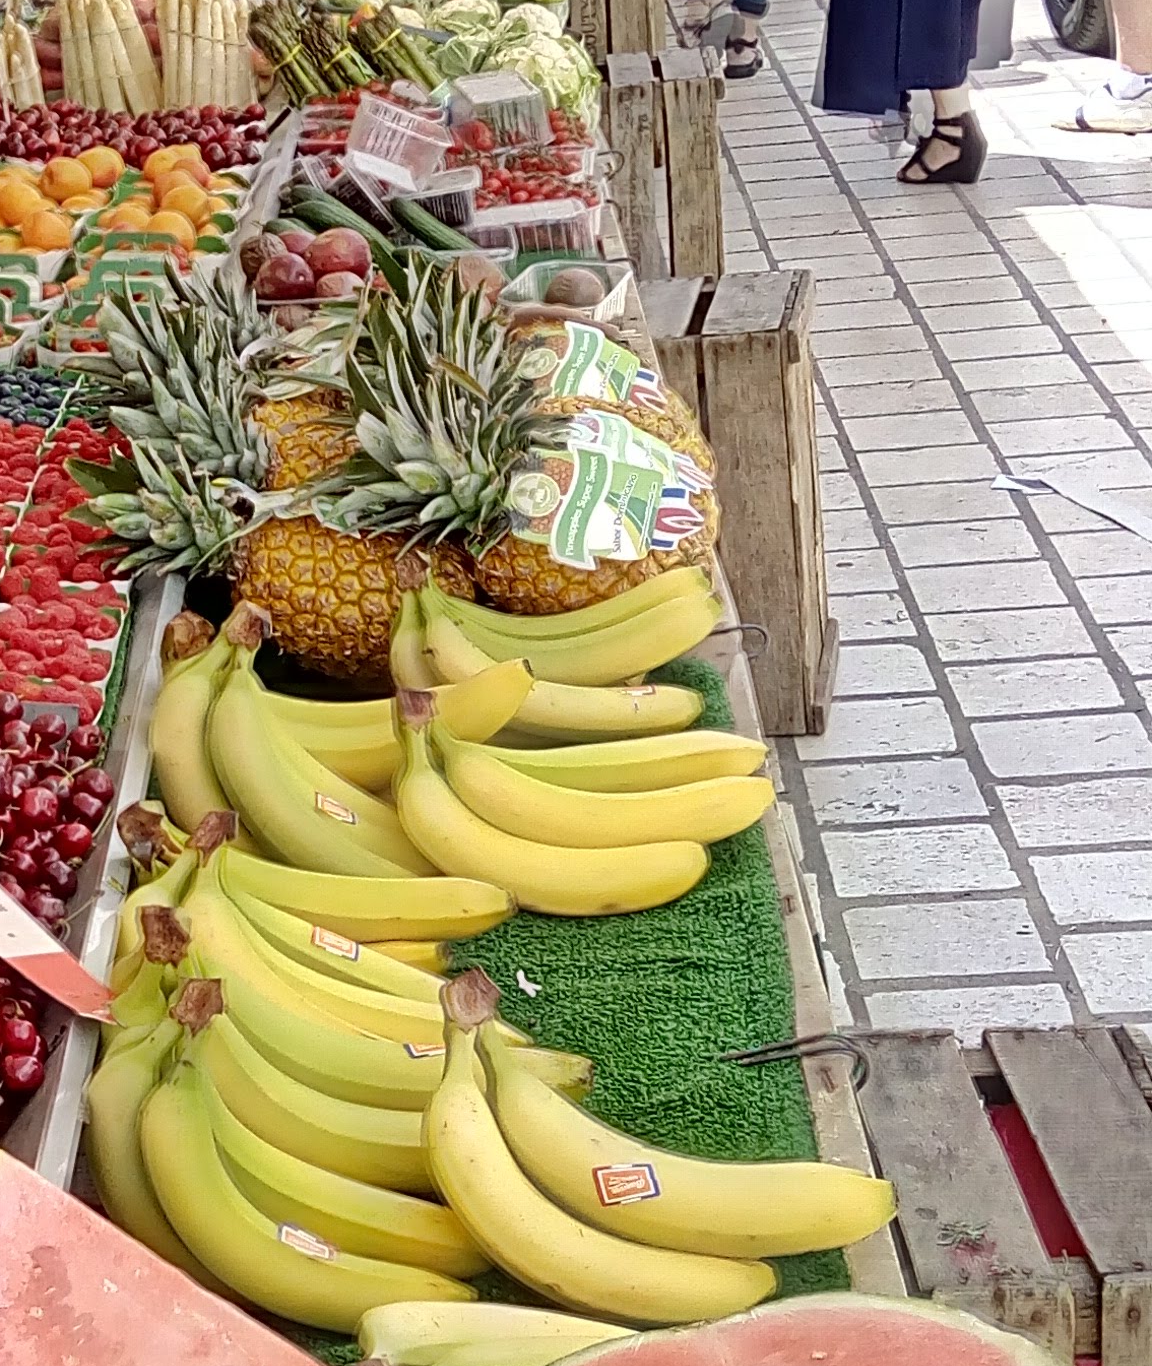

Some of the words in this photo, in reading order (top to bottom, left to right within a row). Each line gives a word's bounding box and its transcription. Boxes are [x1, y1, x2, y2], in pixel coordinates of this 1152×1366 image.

[564, 508, 583, 556] Pineapples
[576, 483, 593, 508] Super
[586, 455, 598, 482] Sweet
[614, 474, 638, 525] Dominicano
[612, 528, 621, 553] Sabor
